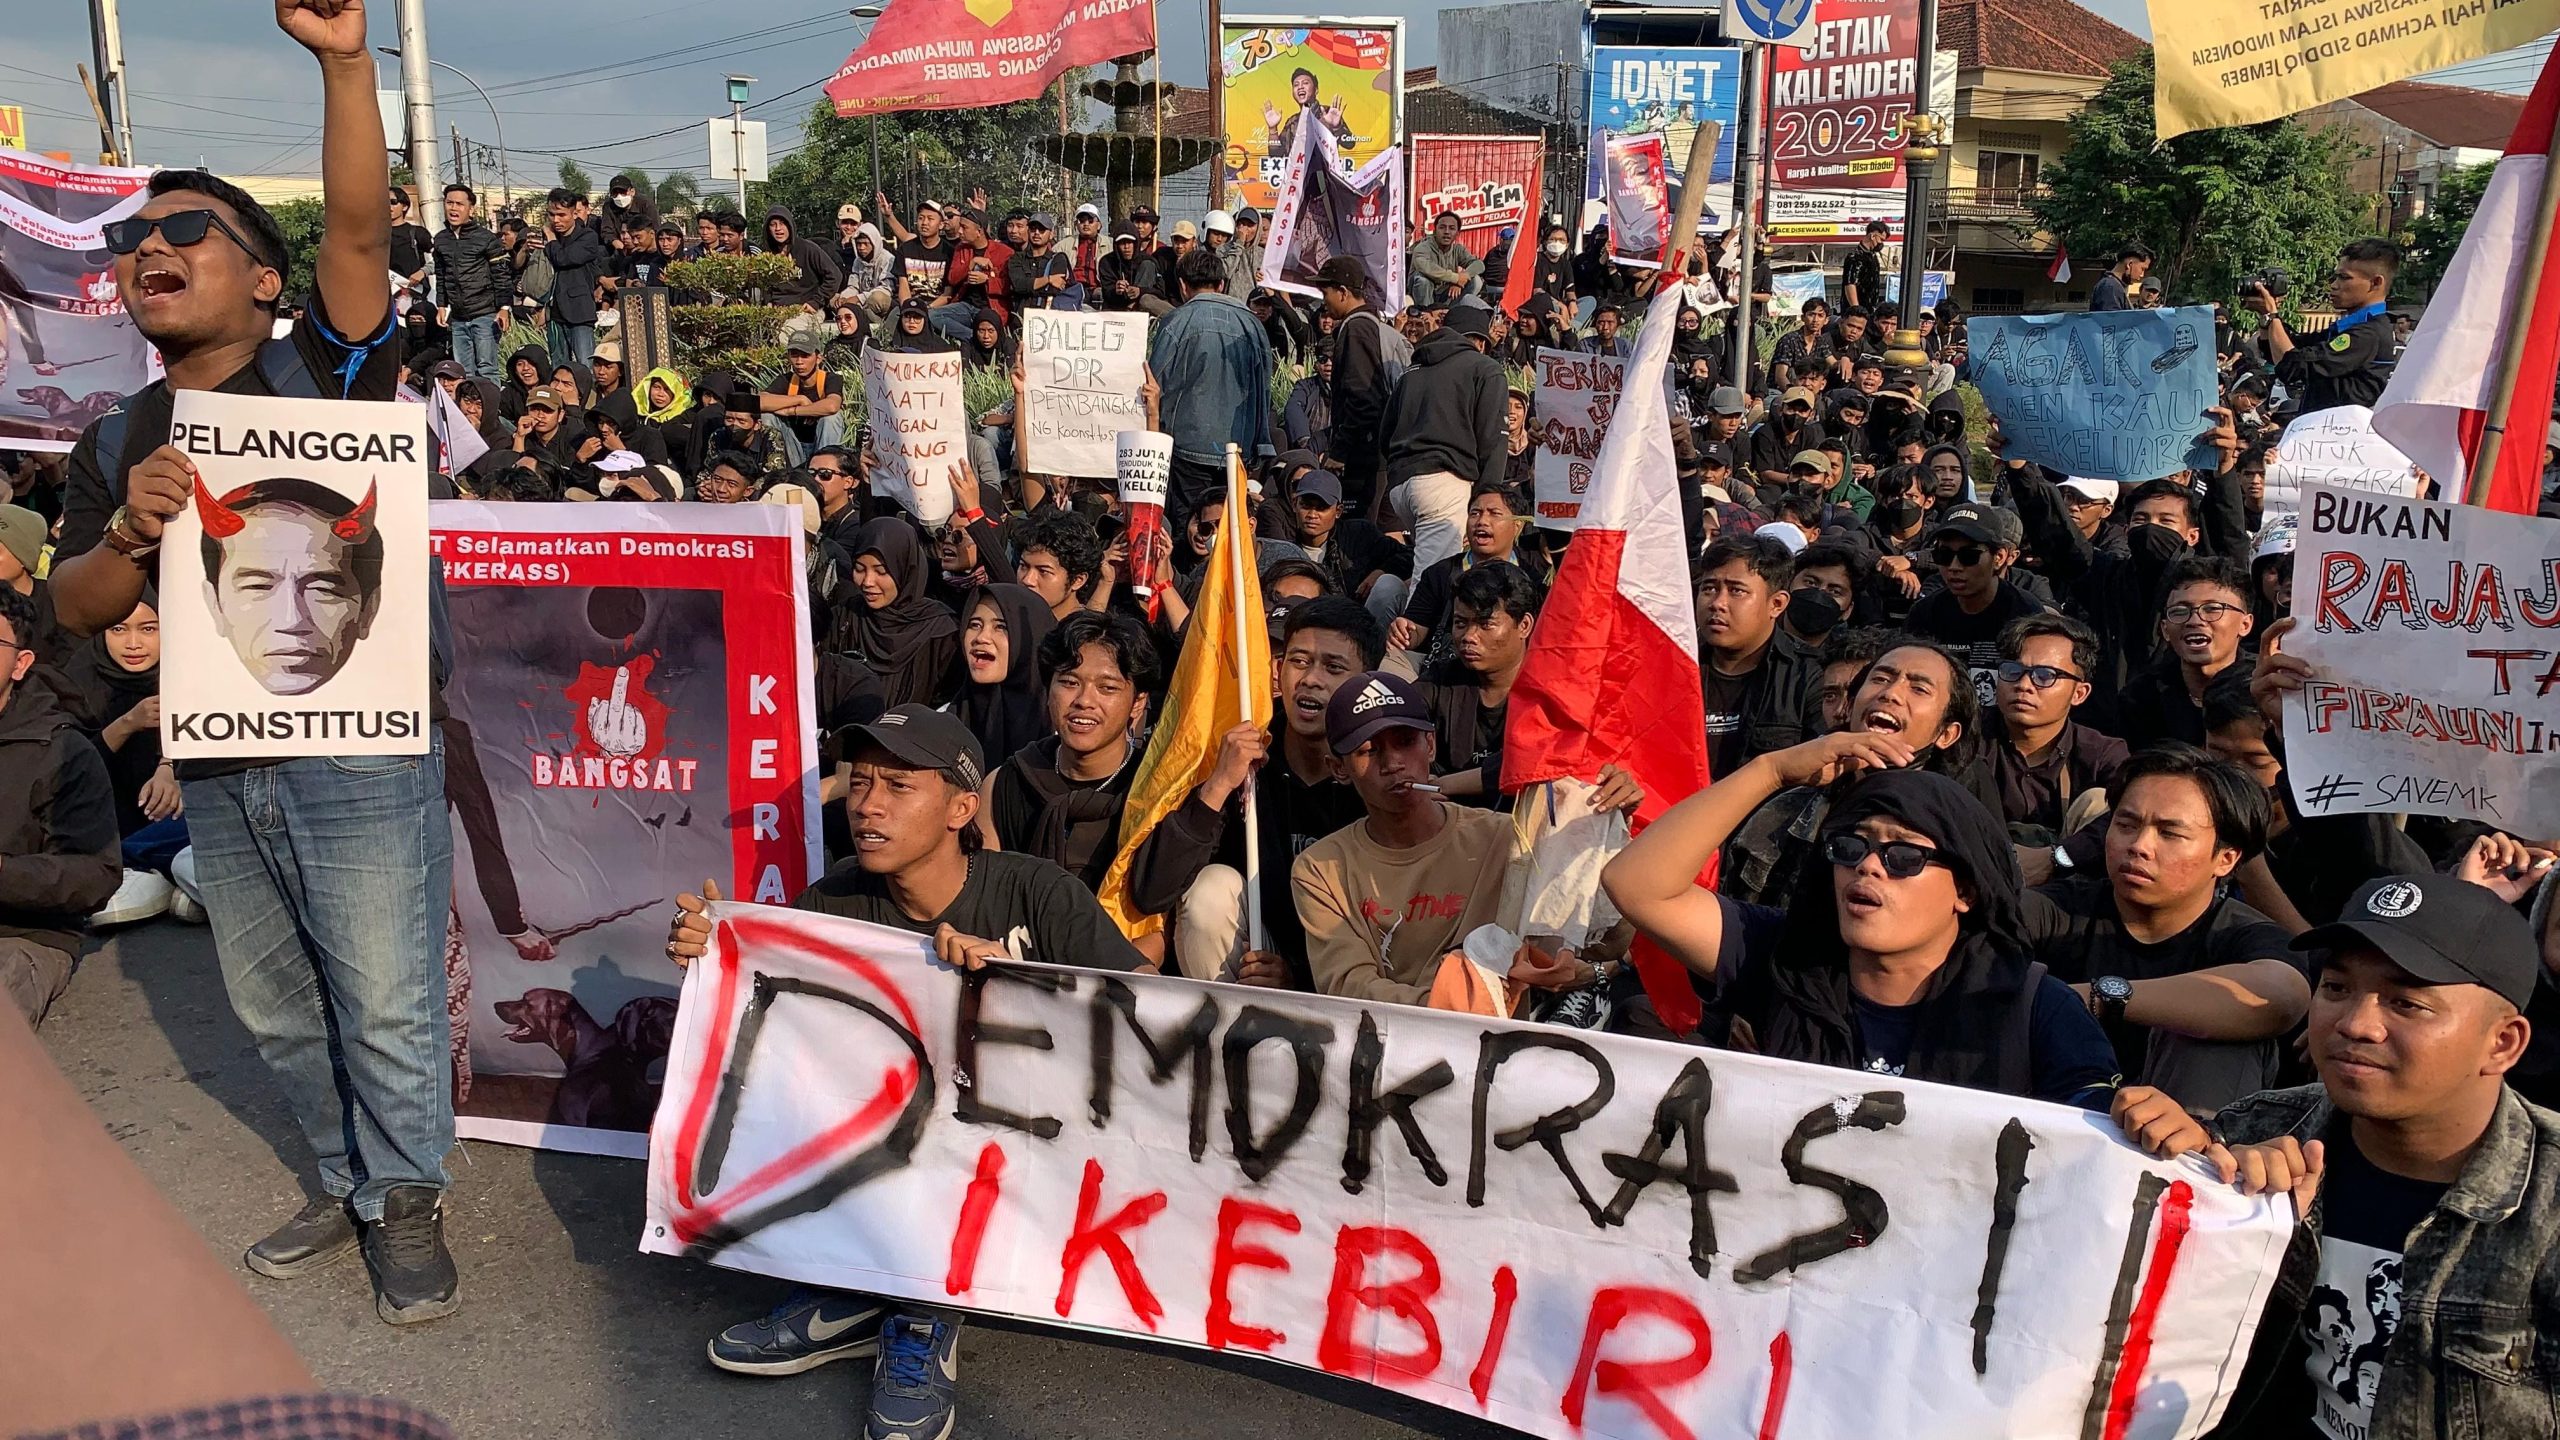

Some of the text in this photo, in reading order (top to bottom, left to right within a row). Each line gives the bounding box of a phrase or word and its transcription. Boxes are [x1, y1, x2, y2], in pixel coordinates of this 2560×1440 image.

[1356, 37, 1374, 46] MAU
[1800, 15, 1892, 62] CETAK
[1611, 60, 1721, 101] IDNET
[1775, 57, 1917, 107] KALENDER
[1774, 103, 1911, 160] 2025
[18, 163, 64, 179] RAKJAT
[67, 174, 132, 186] Selamatkan
[1786, 160, 1894, 179] Harga & Kualitas Bisa Diadu!
[55, 181, 117, 195] (#KERASS)
[1445, 187, 1466, 195] KEBAB
[1462, 210, 1511, 226] KARI PEDAS
[1776, 200, 1845, 208] 081 259 522 522
[10, 219, 76, 249] (#KERASS)
[21, 216, 95, 241] Selamatkan
[1345, 214, 1384, 226] BANGSAT
[1028, 315, 1126, 354] BALEG
[1975, 325, 2142, 389] AGAK
[1053, 356, 1106, 388] DPR
[877, 385, 945, 410] MATI
[2093, 389, 2203, 432] KAU
[1032, 420, 1052, 436] NG
[2322, 414, 2359, 436] Hanya
[173, 422, 416, 463] PELANGGAR
[871, 430, 948, 460] TUKANG
[1119, 449, 1133, 458] 283
[1135, 449, 1165, 461] JUTA
[2279, 440, 2365, 466] UNTUK
[882, 455, 929, 488] KAYU
[2278, 464, 2407, 496] NEGARA
[2313, 491, 2452, 542] BUKAN
[457, 535, 610, 557] Selamatkan
[620, 536, 755, 559] DemokraSi
[1352, 694, 1406, 715] adidas
[171, 710, 420, 742] KONSTITUSI
[534, 754, 697, 791] BANGSAT
[749, 674, 787, 904] KERA
[2386, 886, 2411, 910] VANS
